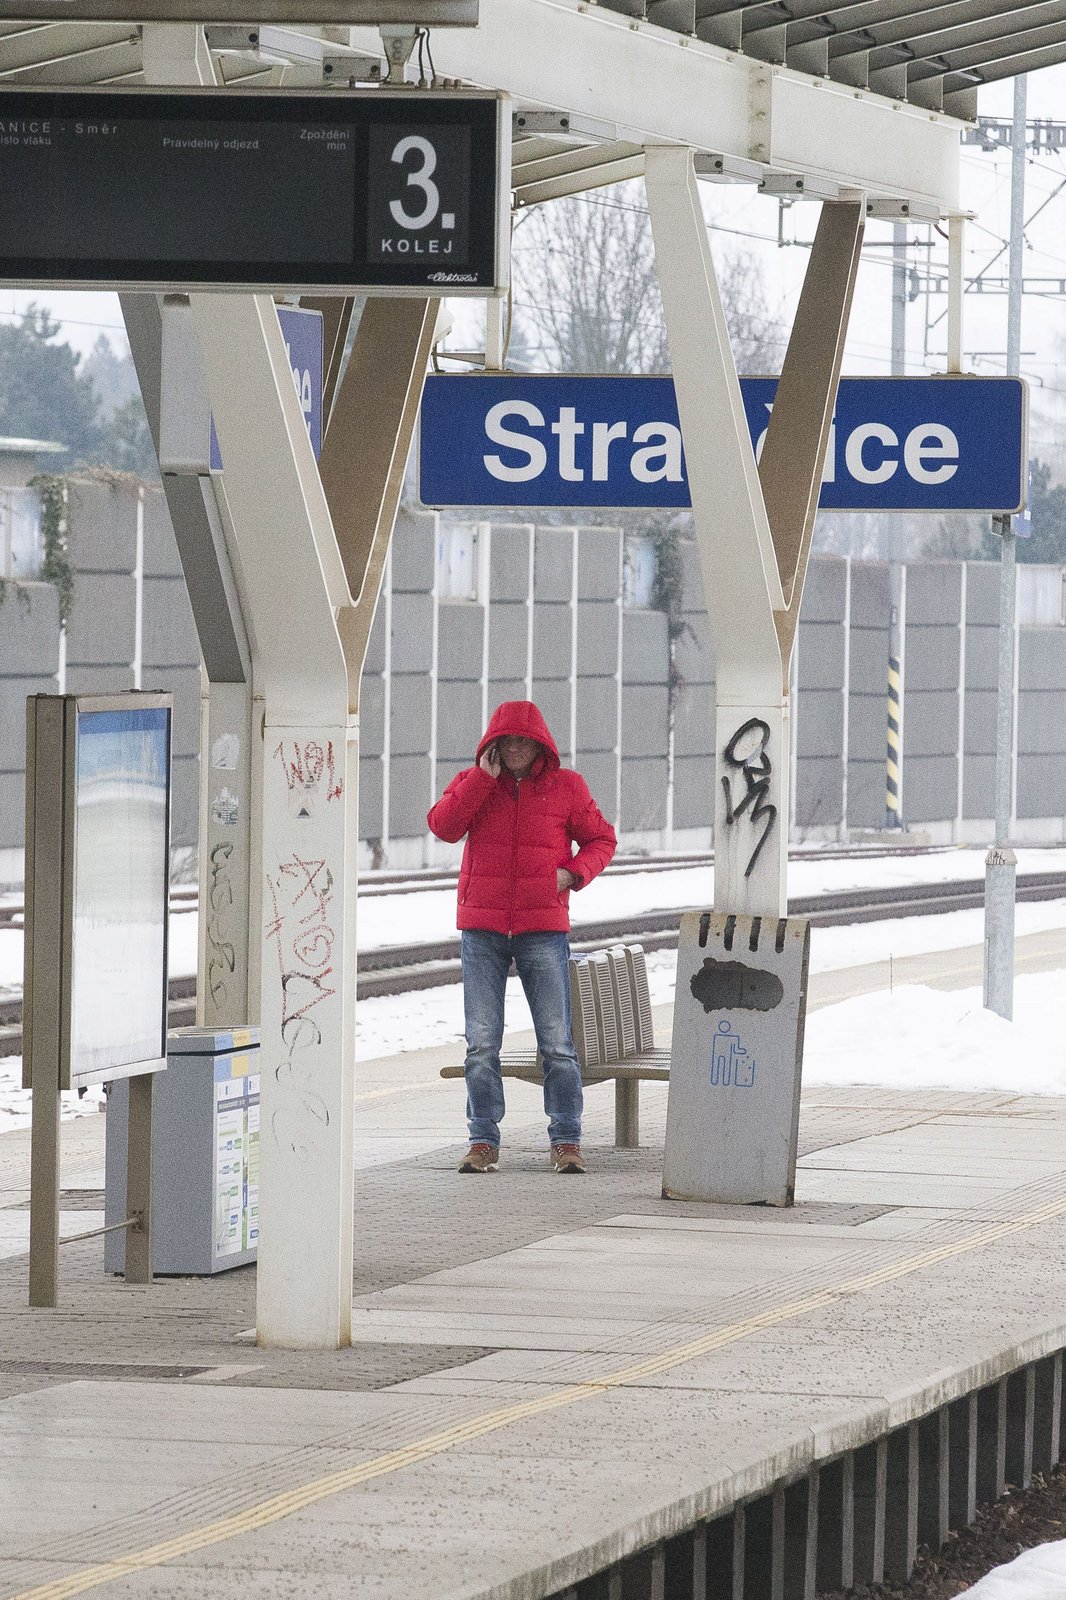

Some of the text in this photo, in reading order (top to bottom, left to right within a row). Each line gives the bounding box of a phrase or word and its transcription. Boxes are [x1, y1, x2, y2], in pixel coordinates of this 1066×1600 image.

[75, 122, 118, 134] Směr
[223, 138, 259, 151] odjezd
[326, 141, 346, 151] min
[389, 135, 455, 230] 3.
[381, 238, 453, 254] KOLEJ
[483, 400, 960, 484] Strace
